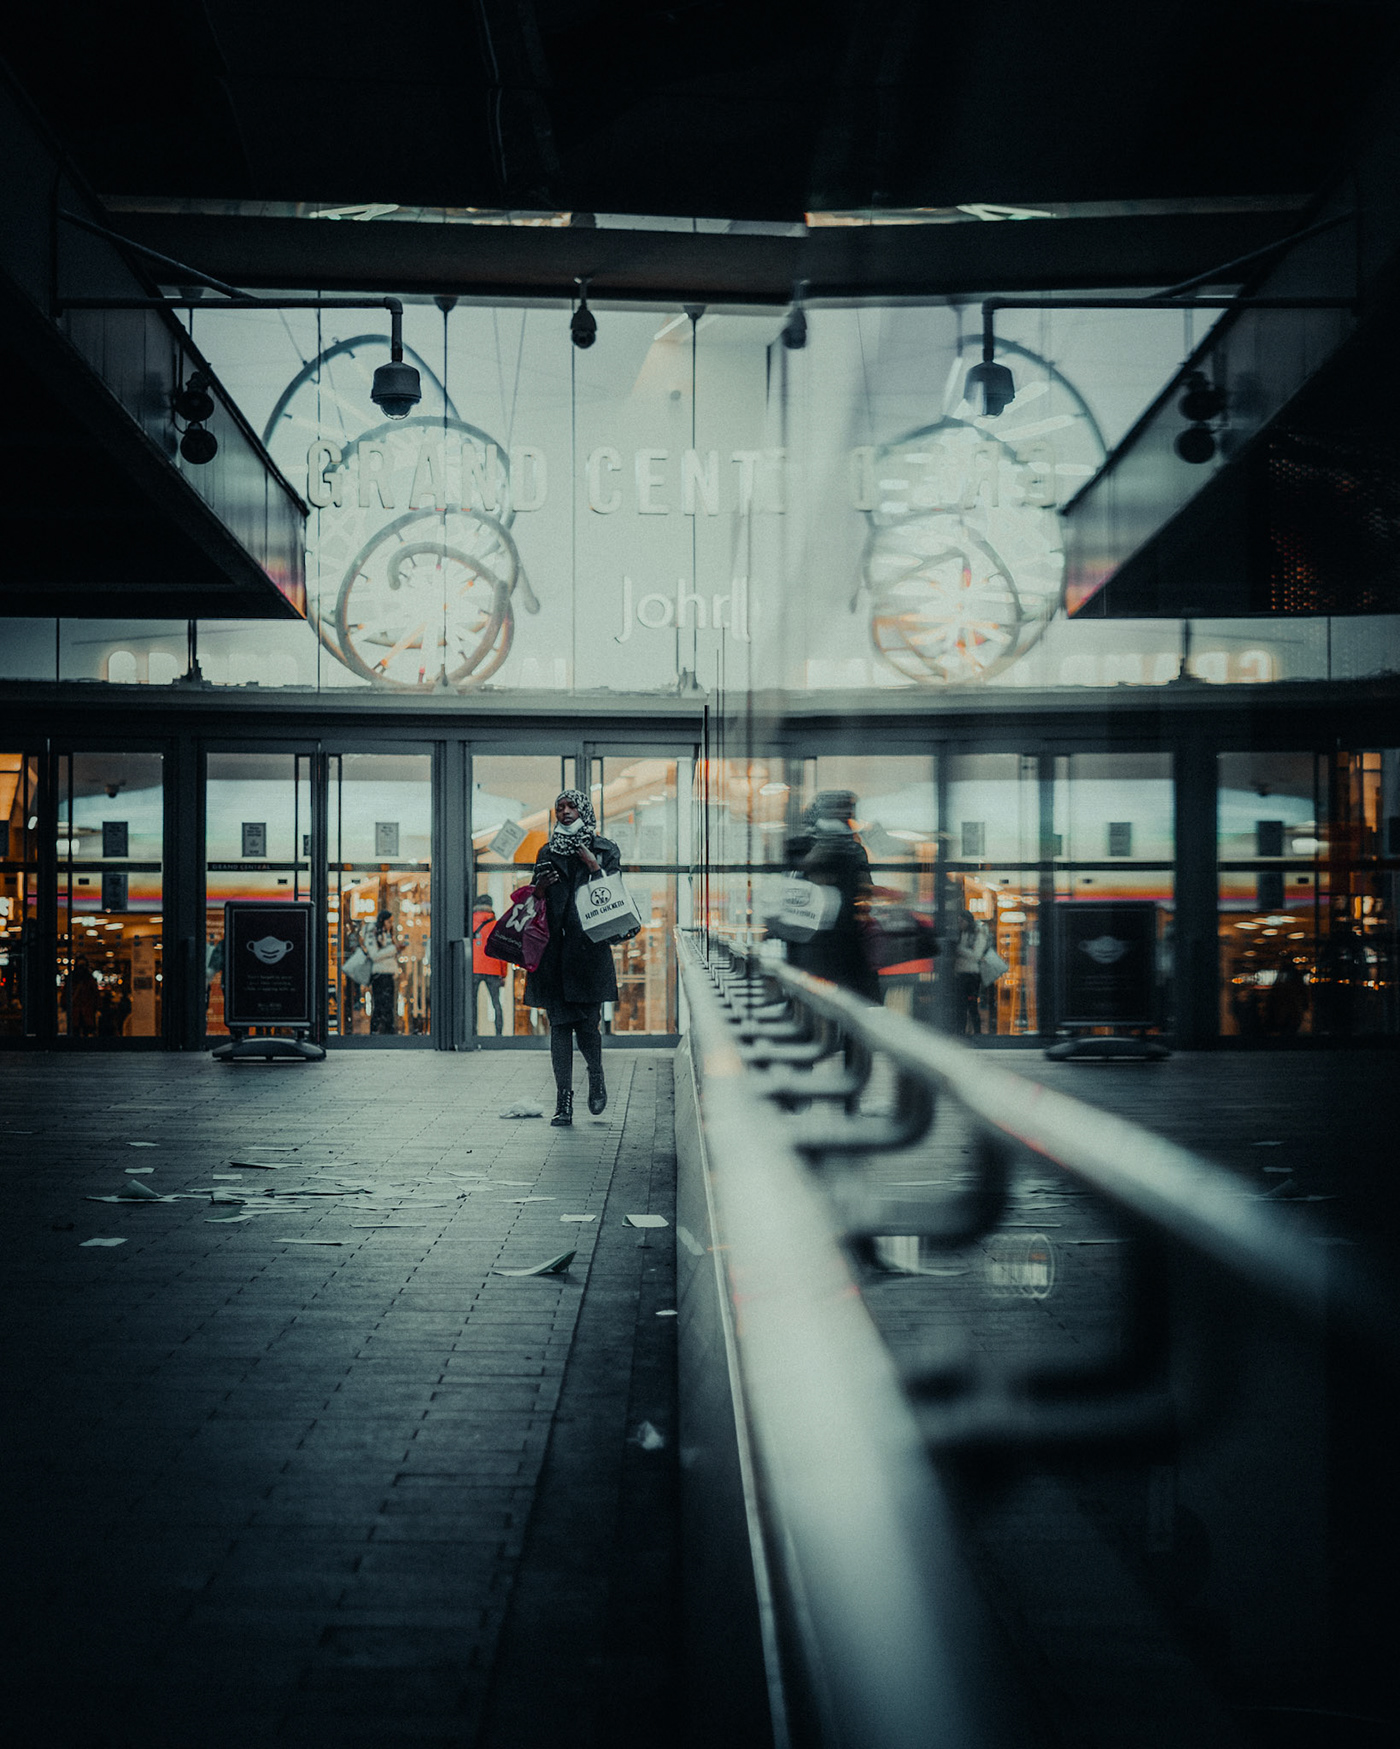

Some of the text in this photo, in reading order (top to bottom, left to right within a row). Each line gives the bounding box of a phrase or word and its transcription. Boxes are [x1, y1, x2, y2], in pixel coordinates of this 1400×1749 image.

[307, 438, 547, 513] GRAND
[211, 863, 271, 871] GRAND CENTRAL
